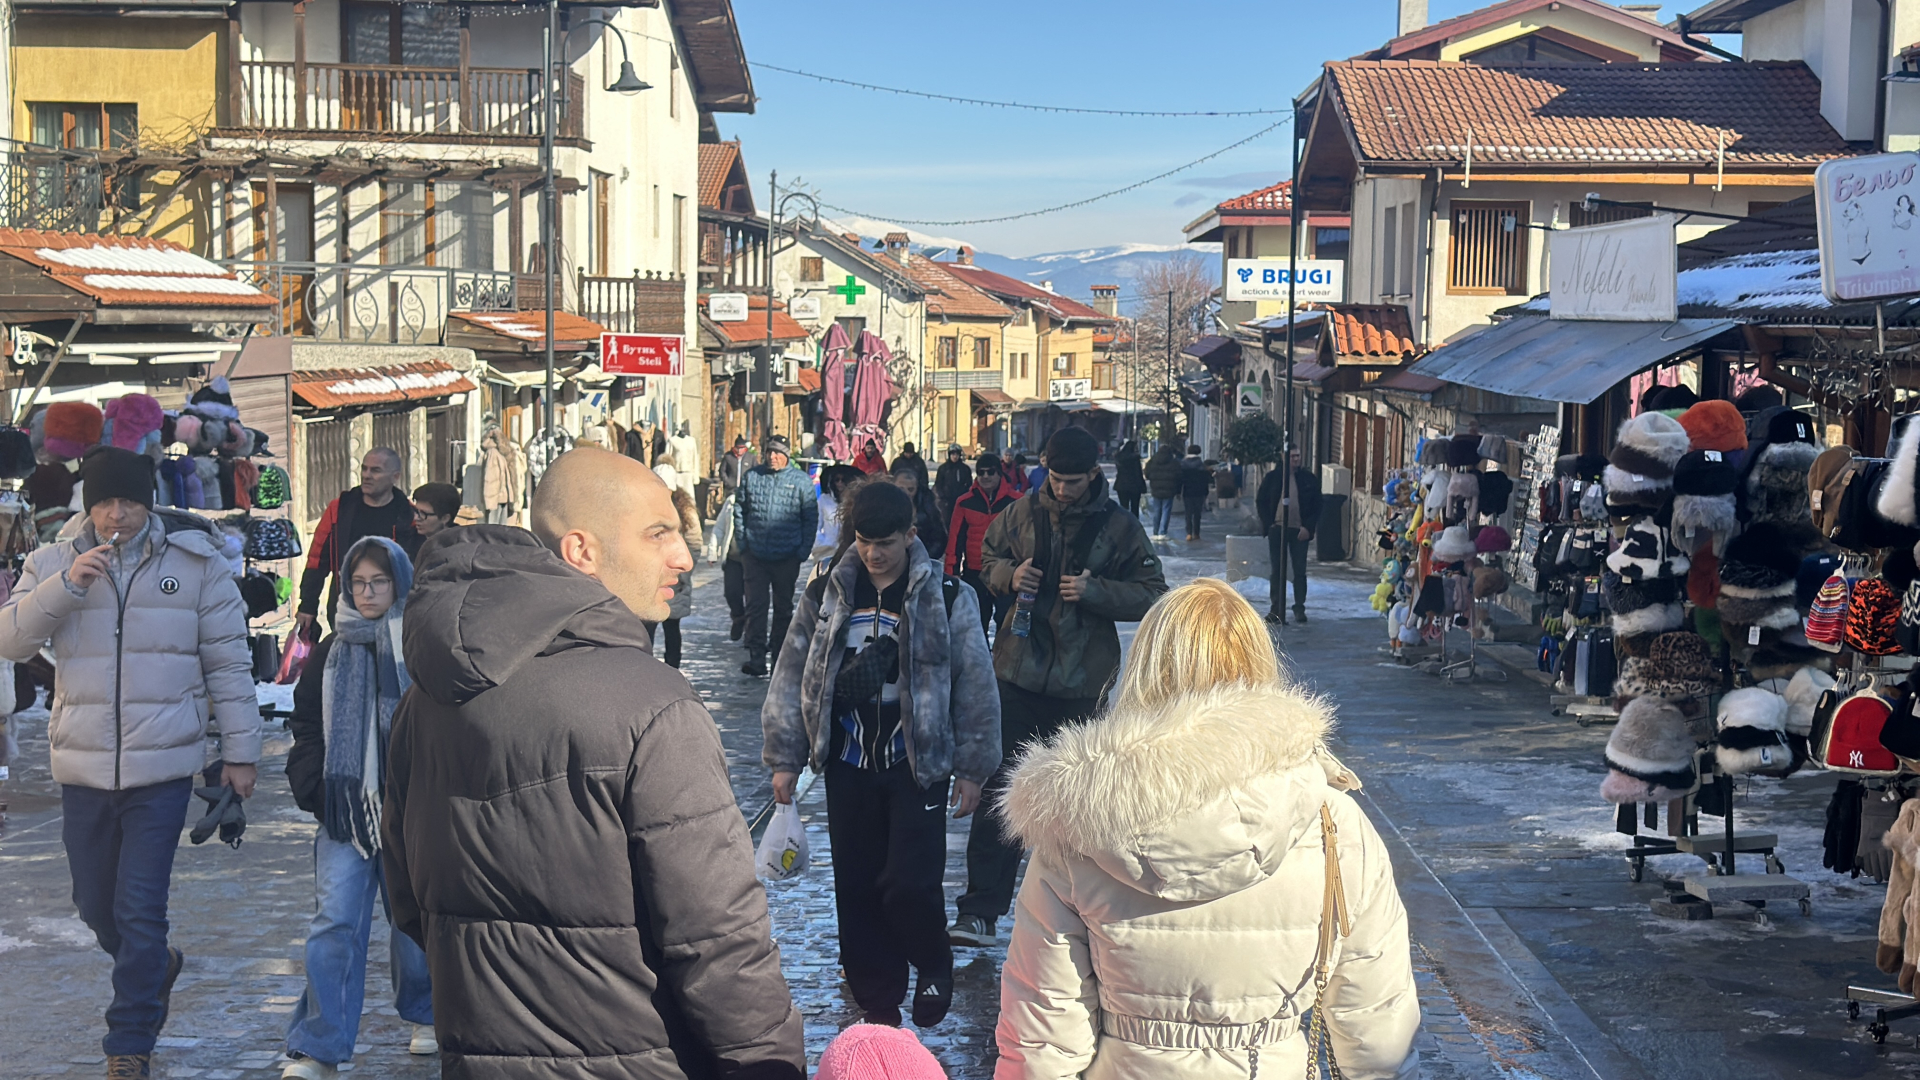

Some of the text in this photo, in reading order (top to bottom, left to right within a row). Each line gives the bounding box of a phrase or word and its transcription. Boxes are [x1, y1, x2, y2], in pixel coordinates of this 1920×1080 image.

[1834, 163, 1917, 203] Бельо
[1262, 269, 1331, 285] BRUGI
[1561, 231, 1628, 312] Nefeli
[1282, 289, 1305, 297] sort
[1308, 289, 1331, 297] wear
[1838, 277, 1913, 297] Triumph
[622, 344, 656, 355] Бутик
[638, 356, 662, 366] Steli
